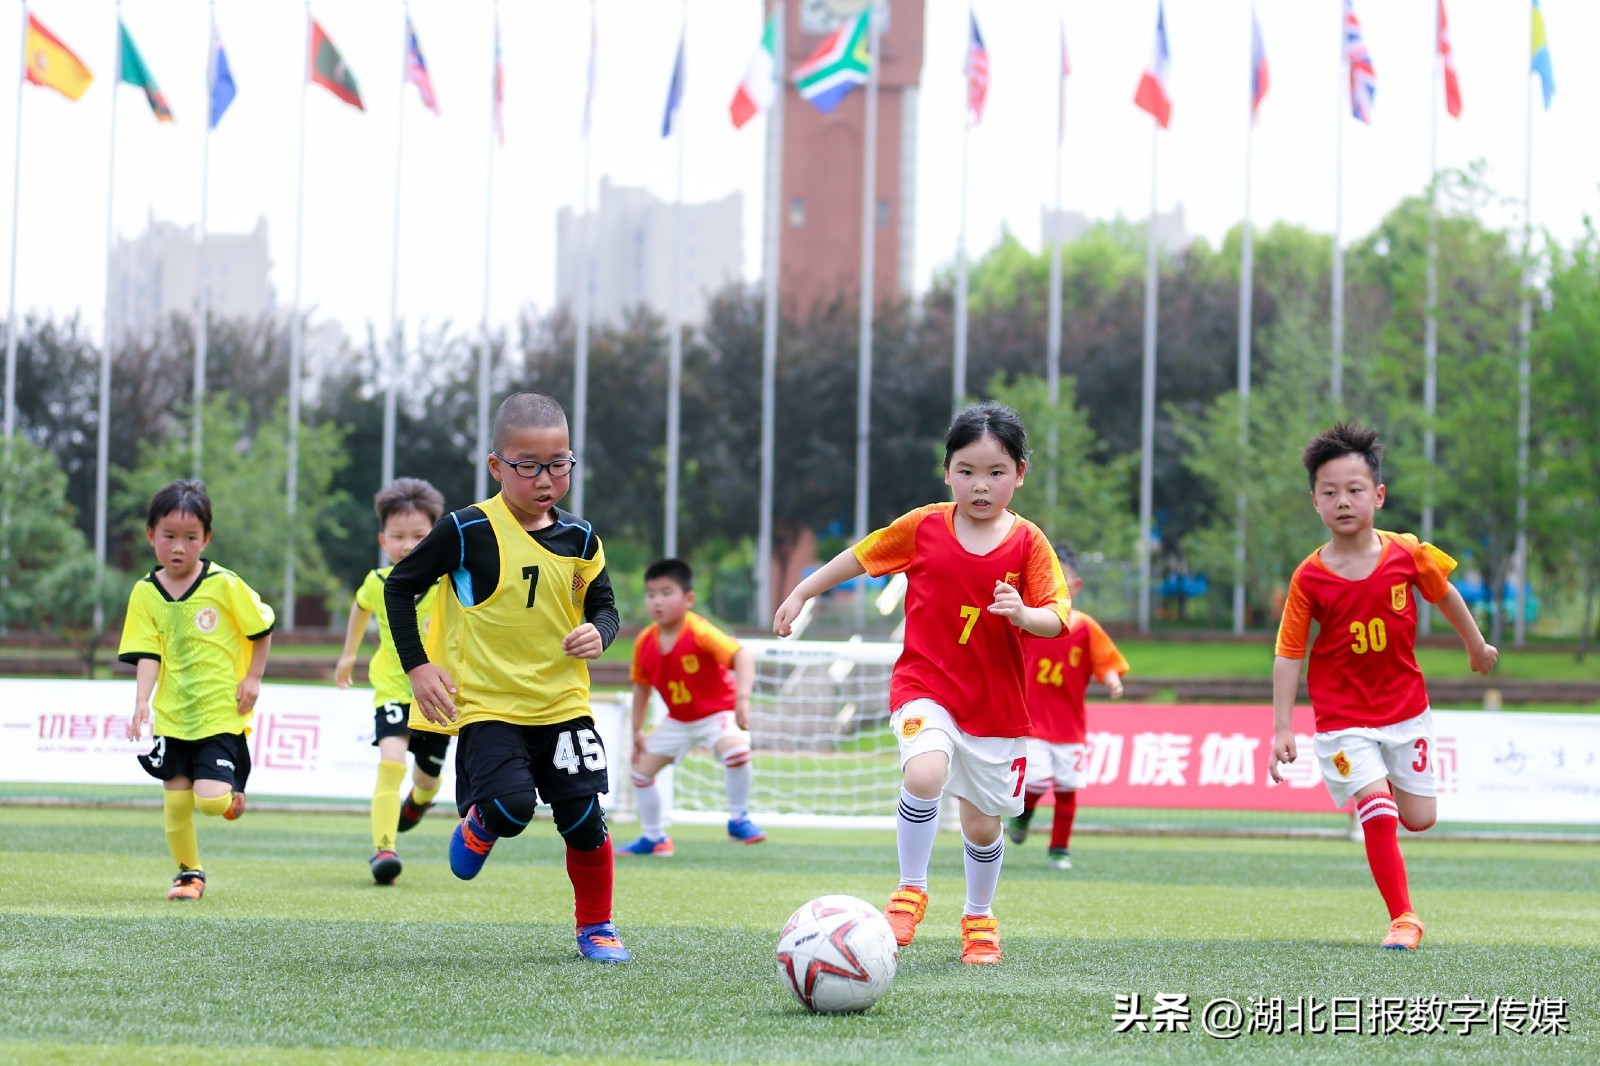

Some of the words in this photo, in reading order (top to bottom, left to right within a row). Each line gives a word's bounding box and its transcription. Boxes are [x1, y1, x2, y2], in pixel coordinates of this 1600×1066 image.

[522, 565, 539, 608] 7
[958, 605, 981, 645] 7
[1350, 617, 1388, 655] 30
[1036, 657, 1064, 687] 24
[667, 680, 692, 705] 26
[553, 729, 607, 775] 45
[1412, 738, 1434, 773] 3
[1010, 756, 1027, 798] 7
